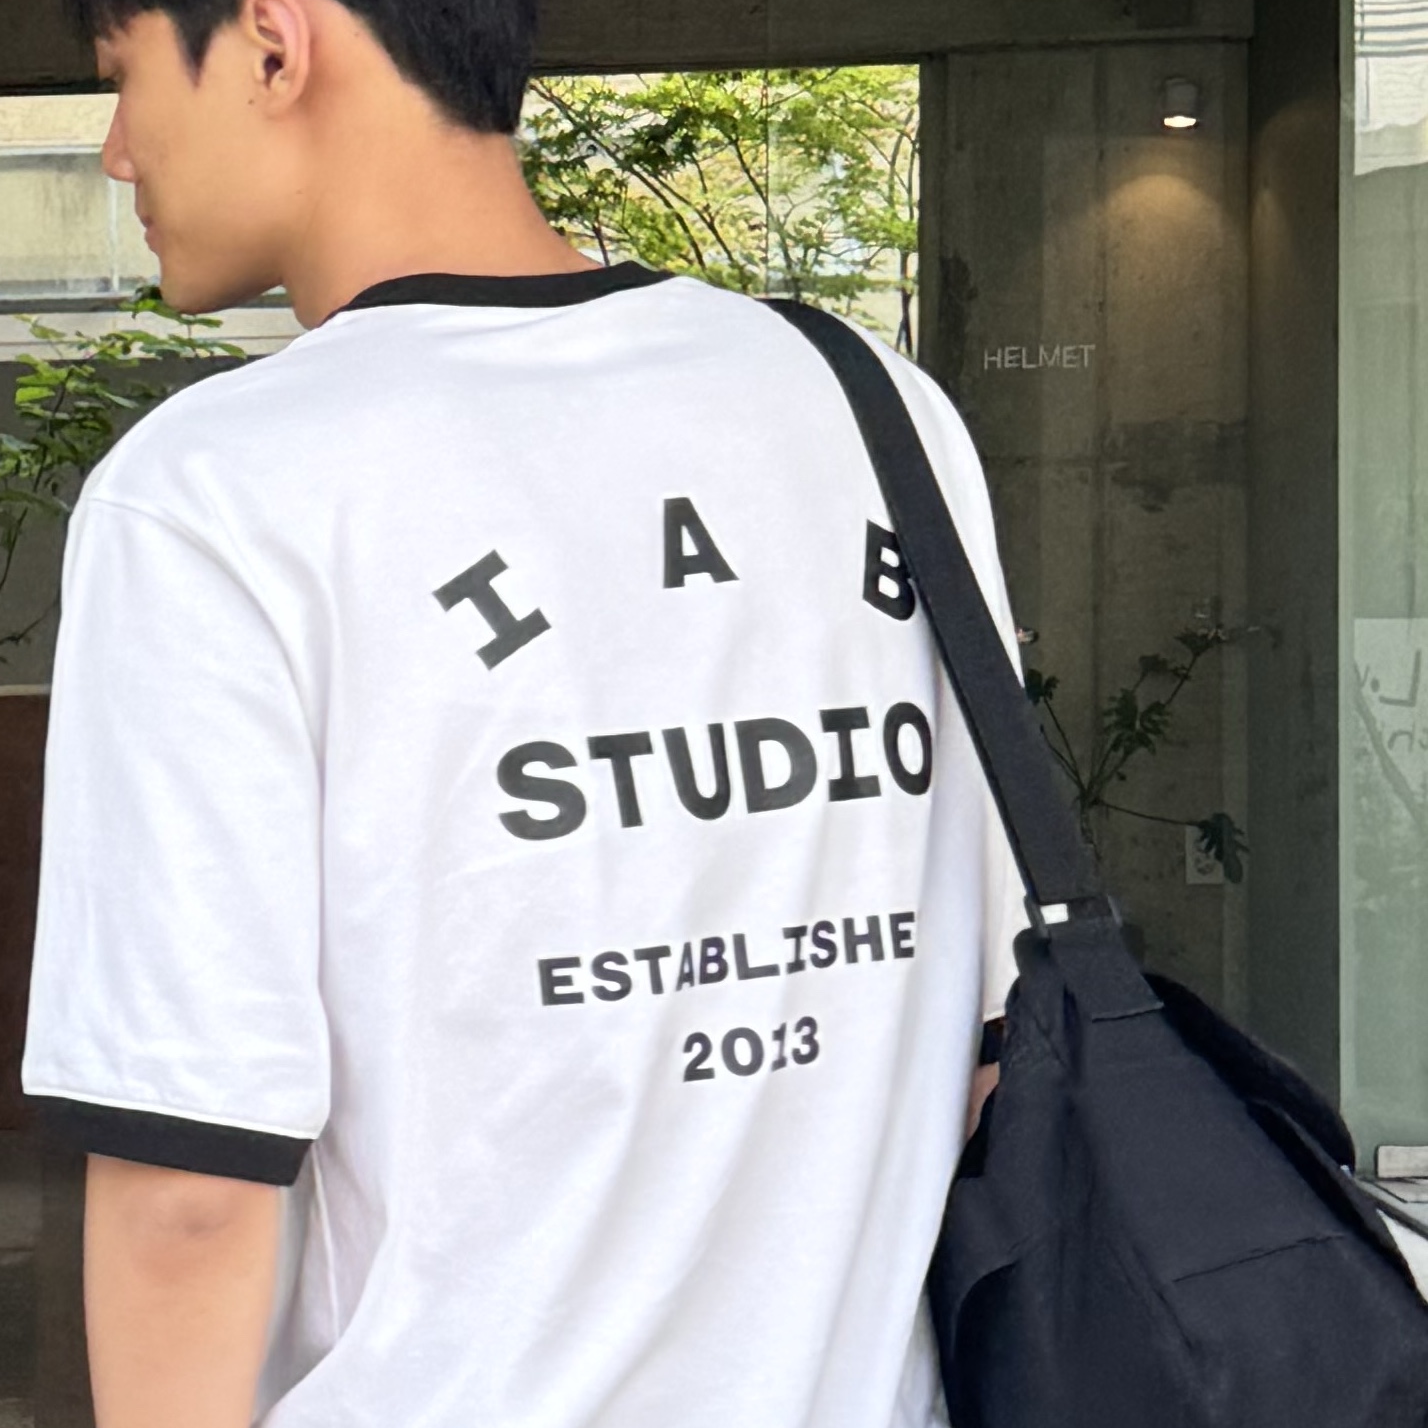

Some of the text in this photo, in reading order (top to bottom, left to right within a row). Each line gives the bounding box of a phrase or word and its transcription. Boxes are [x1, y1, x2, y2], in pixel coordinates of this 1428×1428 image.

[983, 343, 1096, 370] HELMET
[496, 702, 933, 841] STUDIO
[682, 1016, 820, 1083] 2013
